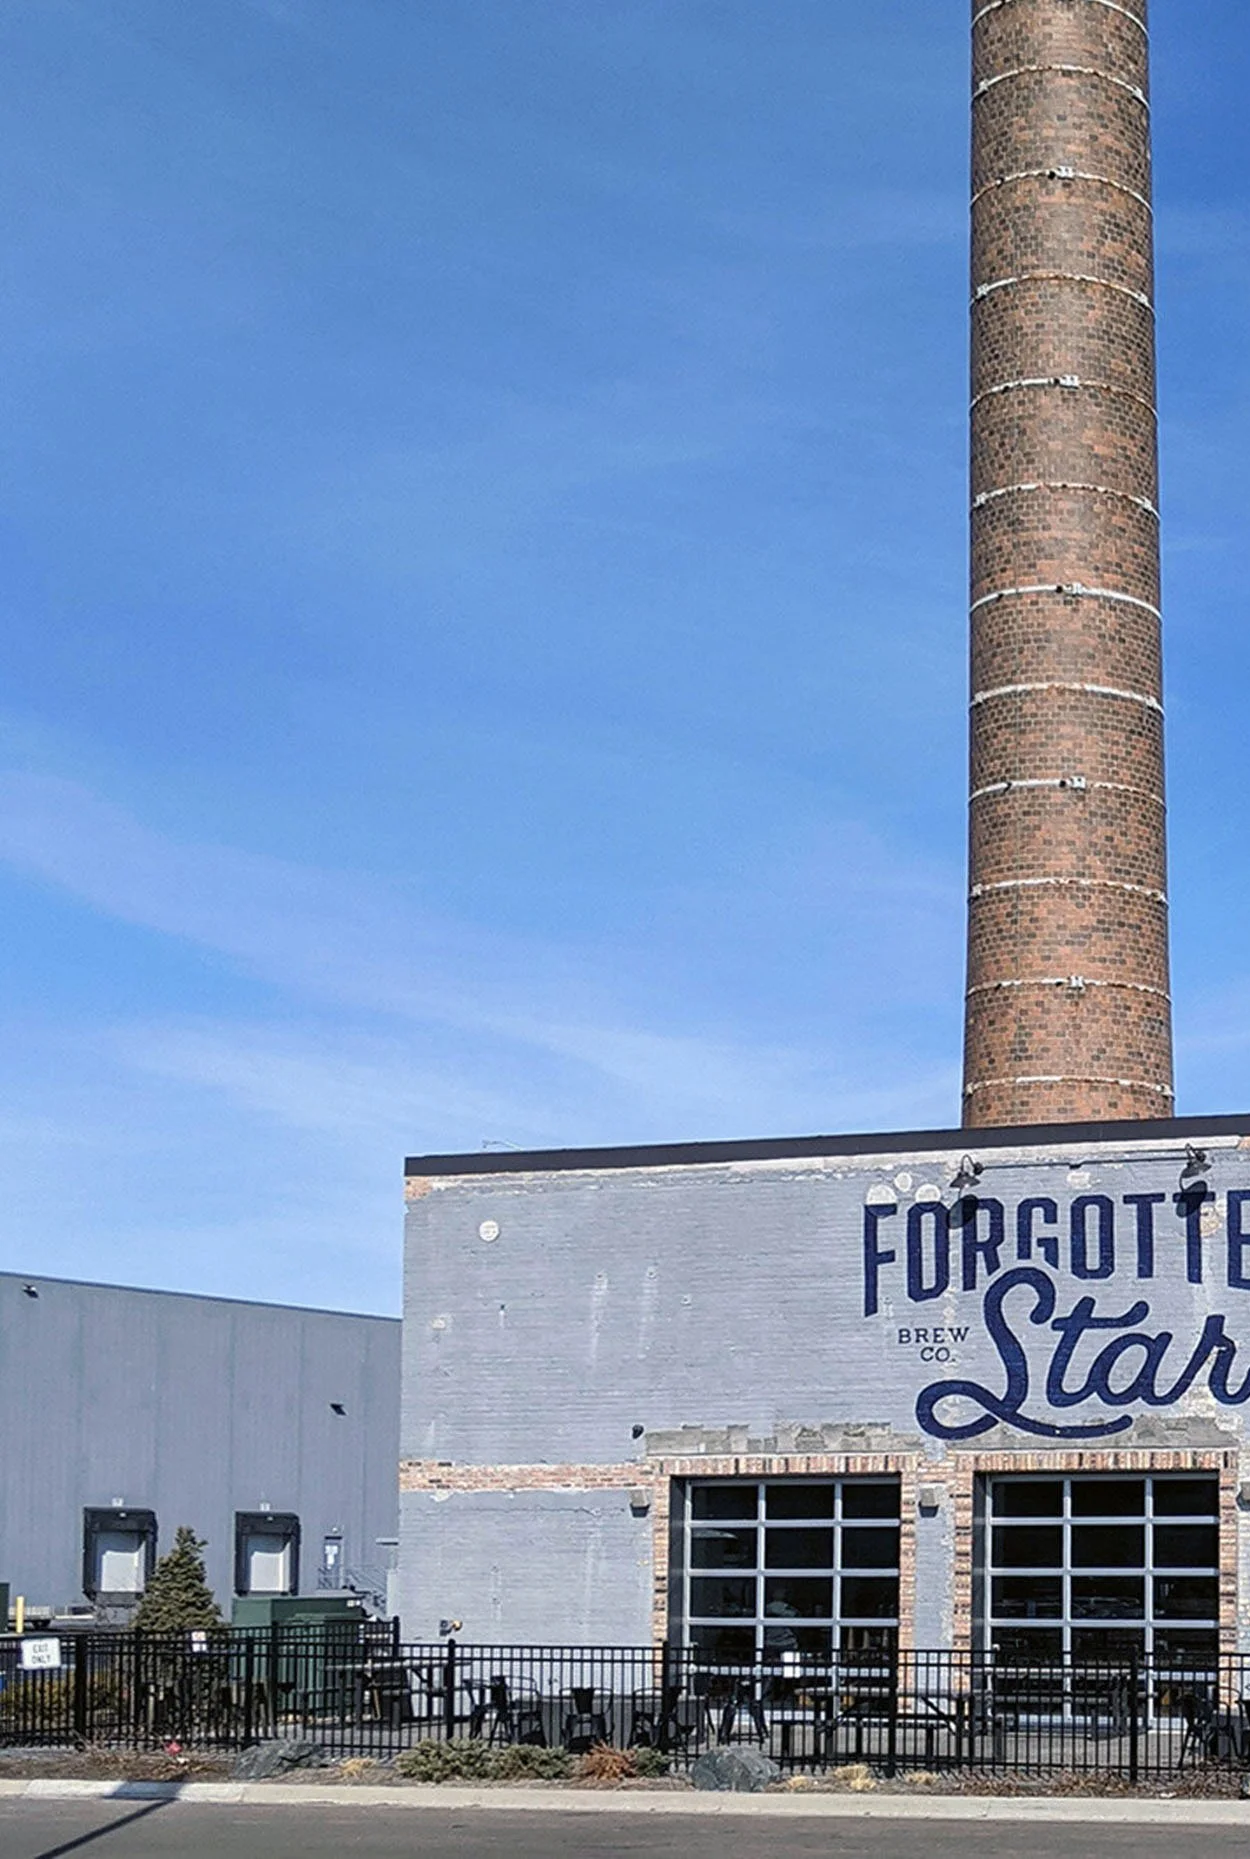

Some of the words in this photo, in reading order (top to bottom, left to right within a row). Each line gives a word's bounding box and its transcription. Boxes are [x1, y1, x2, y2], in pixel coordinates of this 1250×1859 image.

[898, 1326, 970, 1344] BREW
[920, 1346, 956, 1362] CO.
[31, 1654, 51, 1664] ONLY
